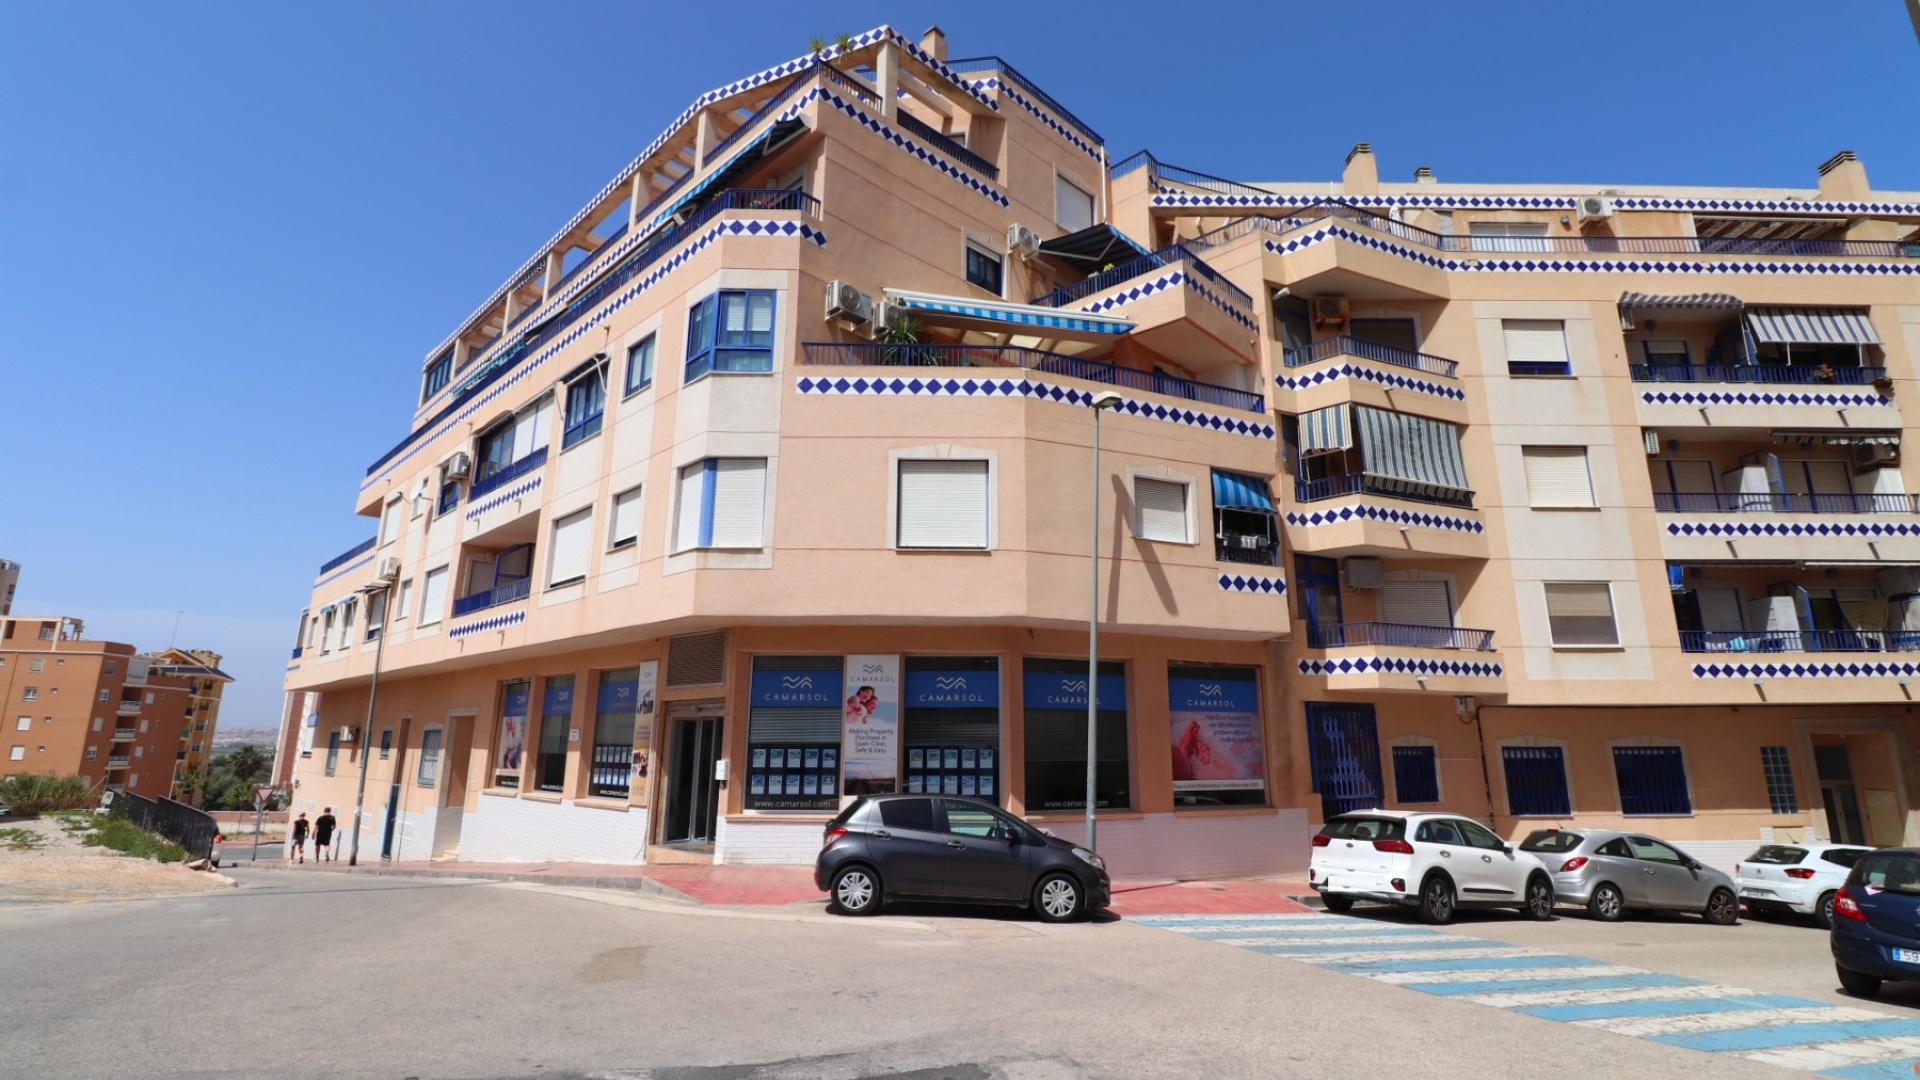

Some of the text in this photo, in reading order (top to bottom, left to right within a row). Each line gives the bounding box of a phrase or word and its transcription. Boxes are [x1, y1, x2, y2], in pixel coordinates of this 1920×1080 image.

[764, 694, 828, 702] CAMARSOL
[919, 694, 984, 702] CAMARSOL
[1047, 696, 1102, 705] CAMARSL
[1187, 699, 1236, 708] CAMARSOL
[754, 799, 831, 808] www.camarsol.com
